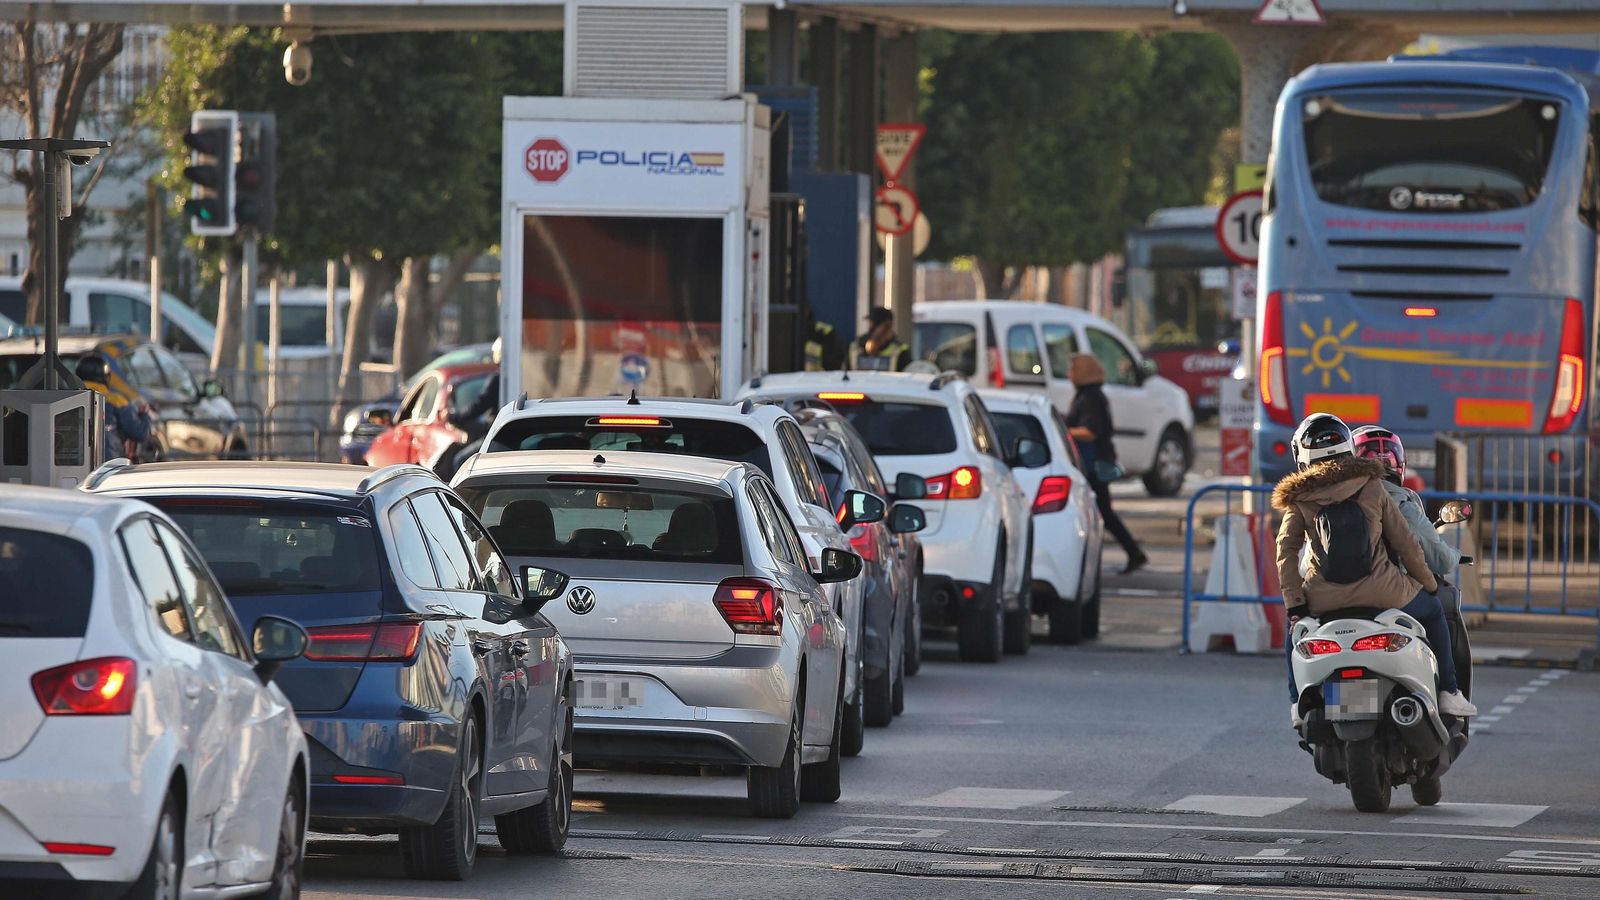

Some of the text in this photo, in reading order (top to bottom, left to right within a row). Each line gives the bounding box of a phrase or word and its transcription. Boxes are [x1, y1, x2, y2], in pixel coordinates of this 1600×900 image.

[527, 149, 567, 171] STOP
[576, 151, 693, 165] POLICIA
[647, 166, 724, 176] NACIONAL
